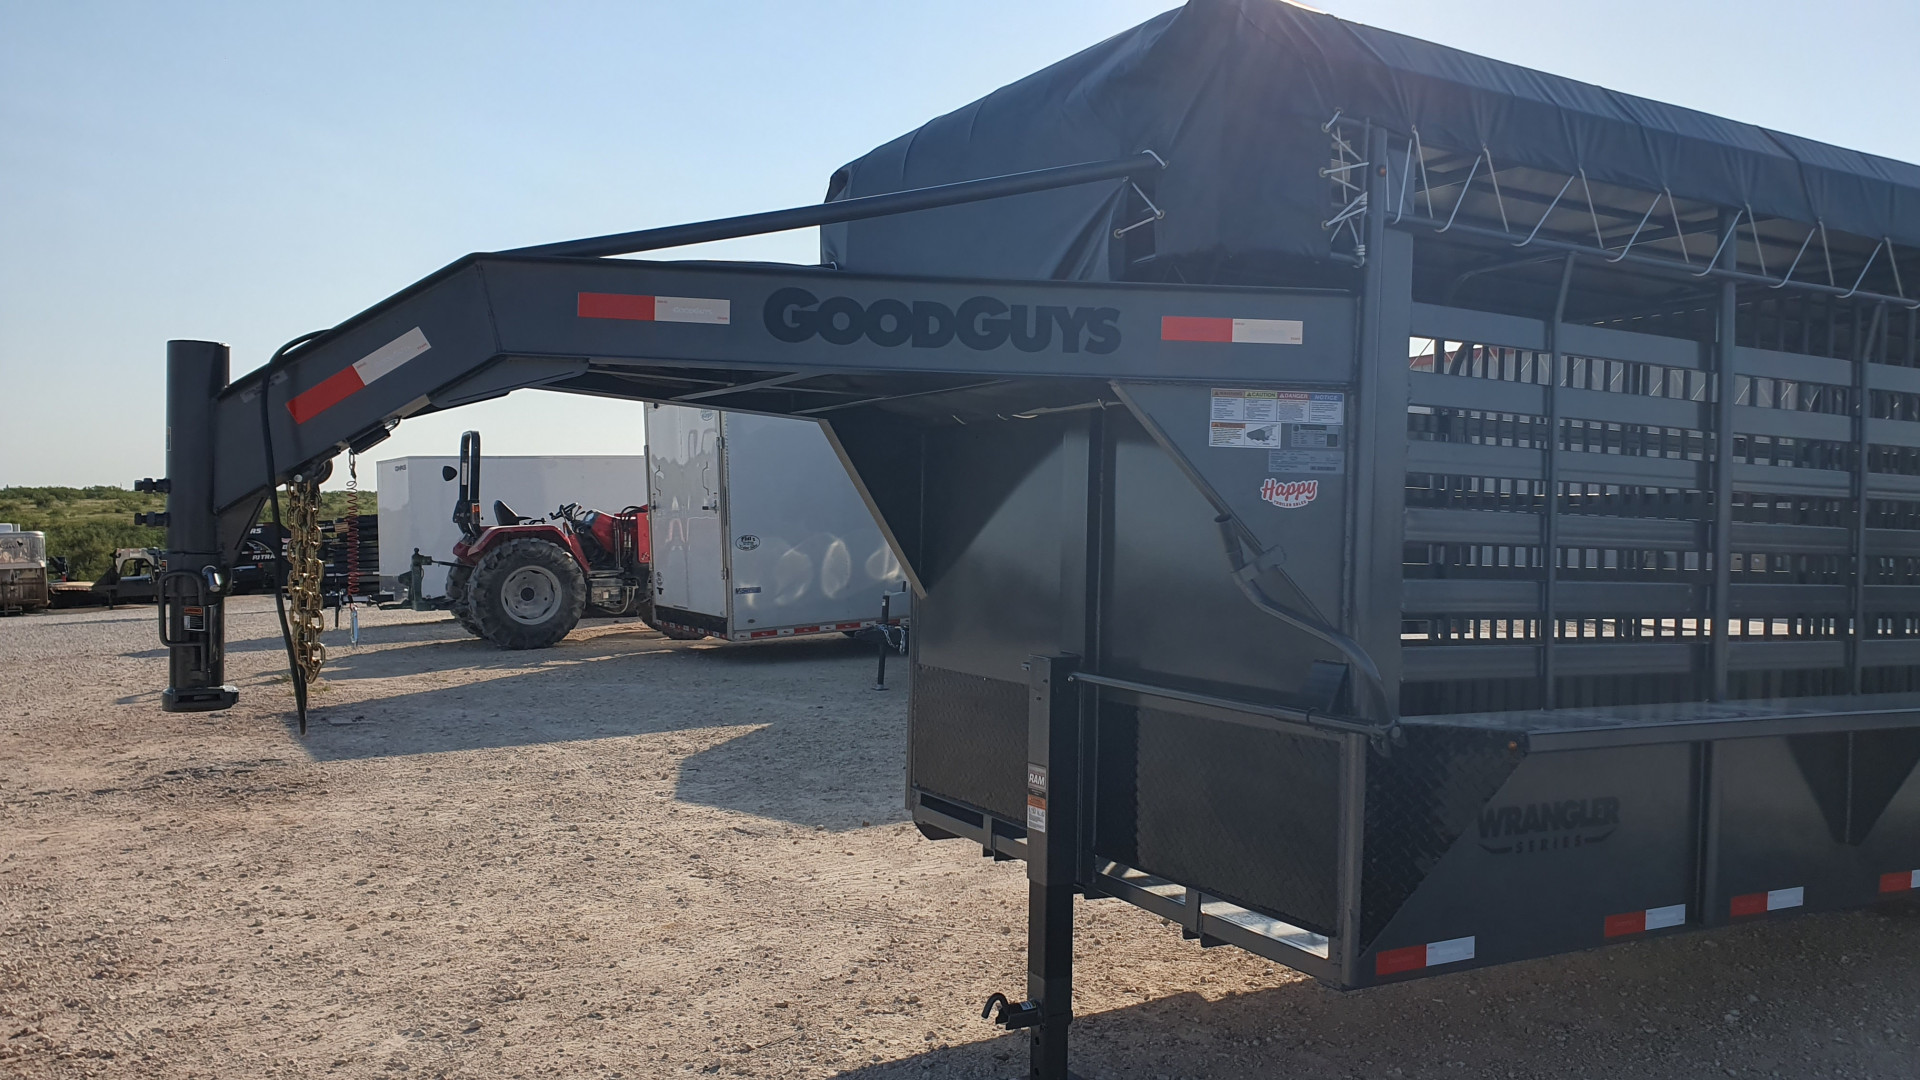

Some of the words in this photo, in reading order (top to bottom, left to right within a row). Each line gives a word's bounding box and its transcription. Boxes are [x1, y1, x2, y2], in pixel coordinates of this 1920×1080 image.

[1261, 479, 1317, 502] Happy
[1029, 773, 1045, 786] RAM
[1477, 796, 1621, 839] WRANGLER
[1515, 835, 1582, 854] SERIES
